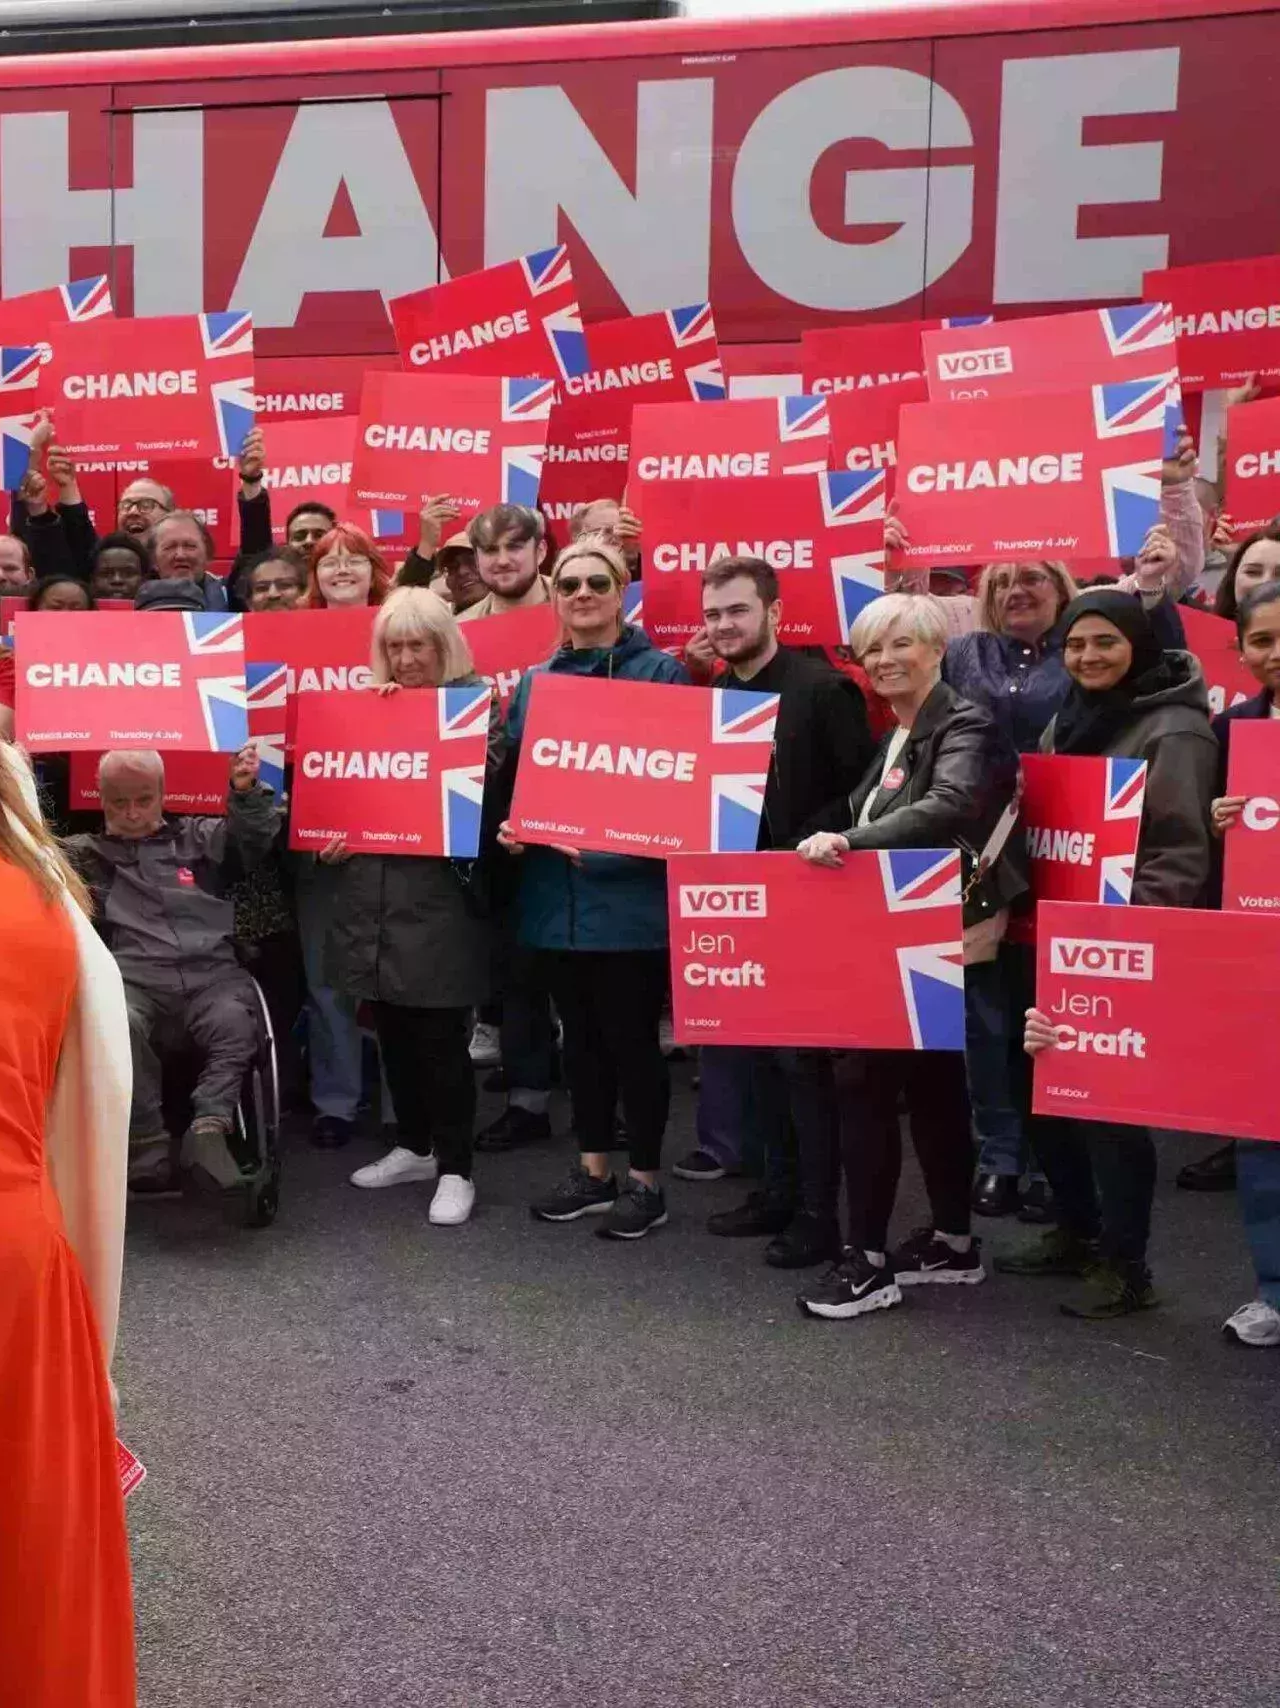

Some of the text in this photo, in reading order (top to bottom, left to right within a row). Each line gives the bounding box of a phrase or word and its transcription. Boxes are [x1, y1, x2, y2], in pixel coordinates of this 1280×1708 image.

[1173, 305, 1280, 337] HANGE
[410, 310, 530, 365] CHANGE
[565, 358, 674, 396] CHANGE
[943, 352, 1007, 374] VOTE
[63, 369, 198, 400] CHANGE
[253, 393, 344, 412] CHANGE
[364, 424, 491, 454] CHANGE
[543, 444, 629, 462] HANGE
[261, 462, 354, 489] HANGE
[637, 452, 770, 480] CHANGE
[907, 452, 1083, 493] CHANGE
[653, 539, 814, 572] CHANGE
[993, 540, 1043, 552] Thursday
[1056, 537, 1079, 548] July
[26, 662, 181, 688] CHANGE
[109, 731, 154, 741] Thursday
[302, 750, 429, 780] CHANGE
[531, 737, 697, 782] CHANGE
[362, 831, 398, 843] Thursday
[605, 829, 651, 846] Thursday
[661, 836, 684, 850] July
[1025, 826, 1096, 867] HANGE
[685, 890, 760, 912] VOTE
[682, 930, 735, 954] Jen
[683, 960, 766, 987] Craft
[1058, 944, 1145, 974] VOTE
[1051, 988, 1112, 1018] Jen
[1052, 1023, 1146, 1059] Craft
